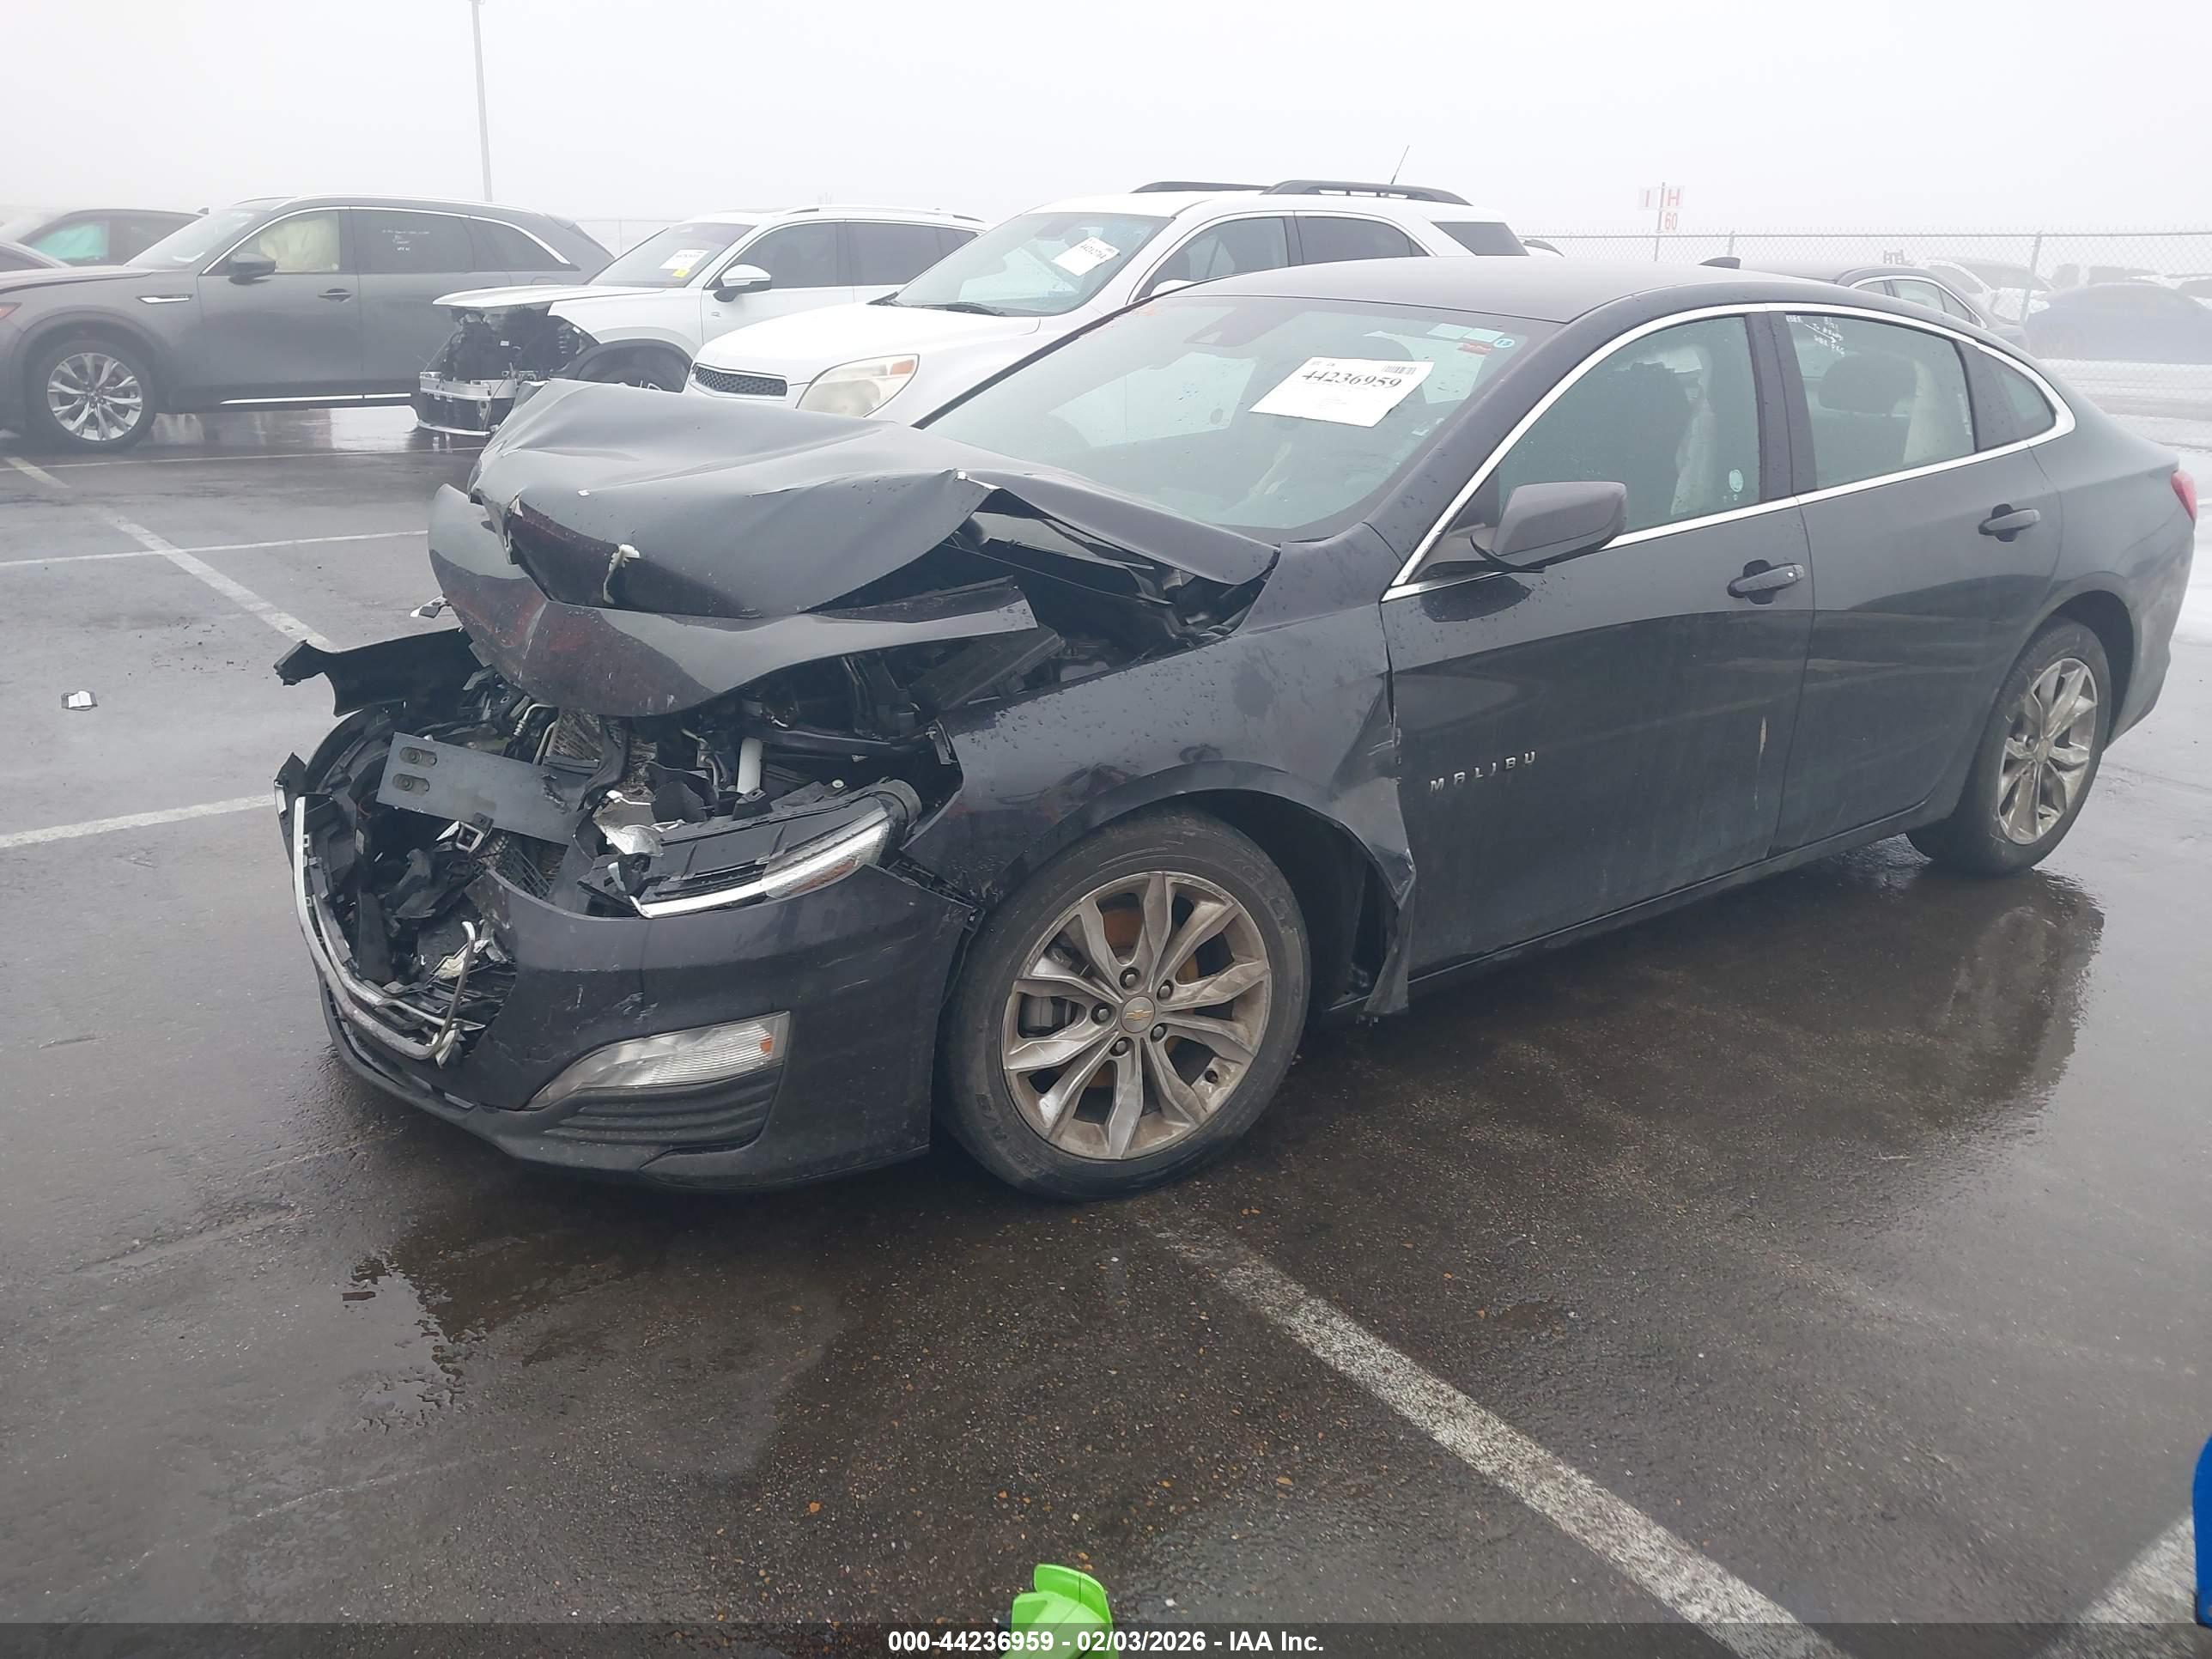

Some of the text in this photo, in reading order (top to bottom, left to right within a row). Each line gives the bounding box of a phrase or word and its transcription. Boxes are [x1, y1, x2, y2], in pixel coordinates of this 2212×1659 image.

[1668, 188, 1680, 207] H
[1302, 370, 1402, 388] 44236959
[1430, 750, 1536, 792] MALIBU
